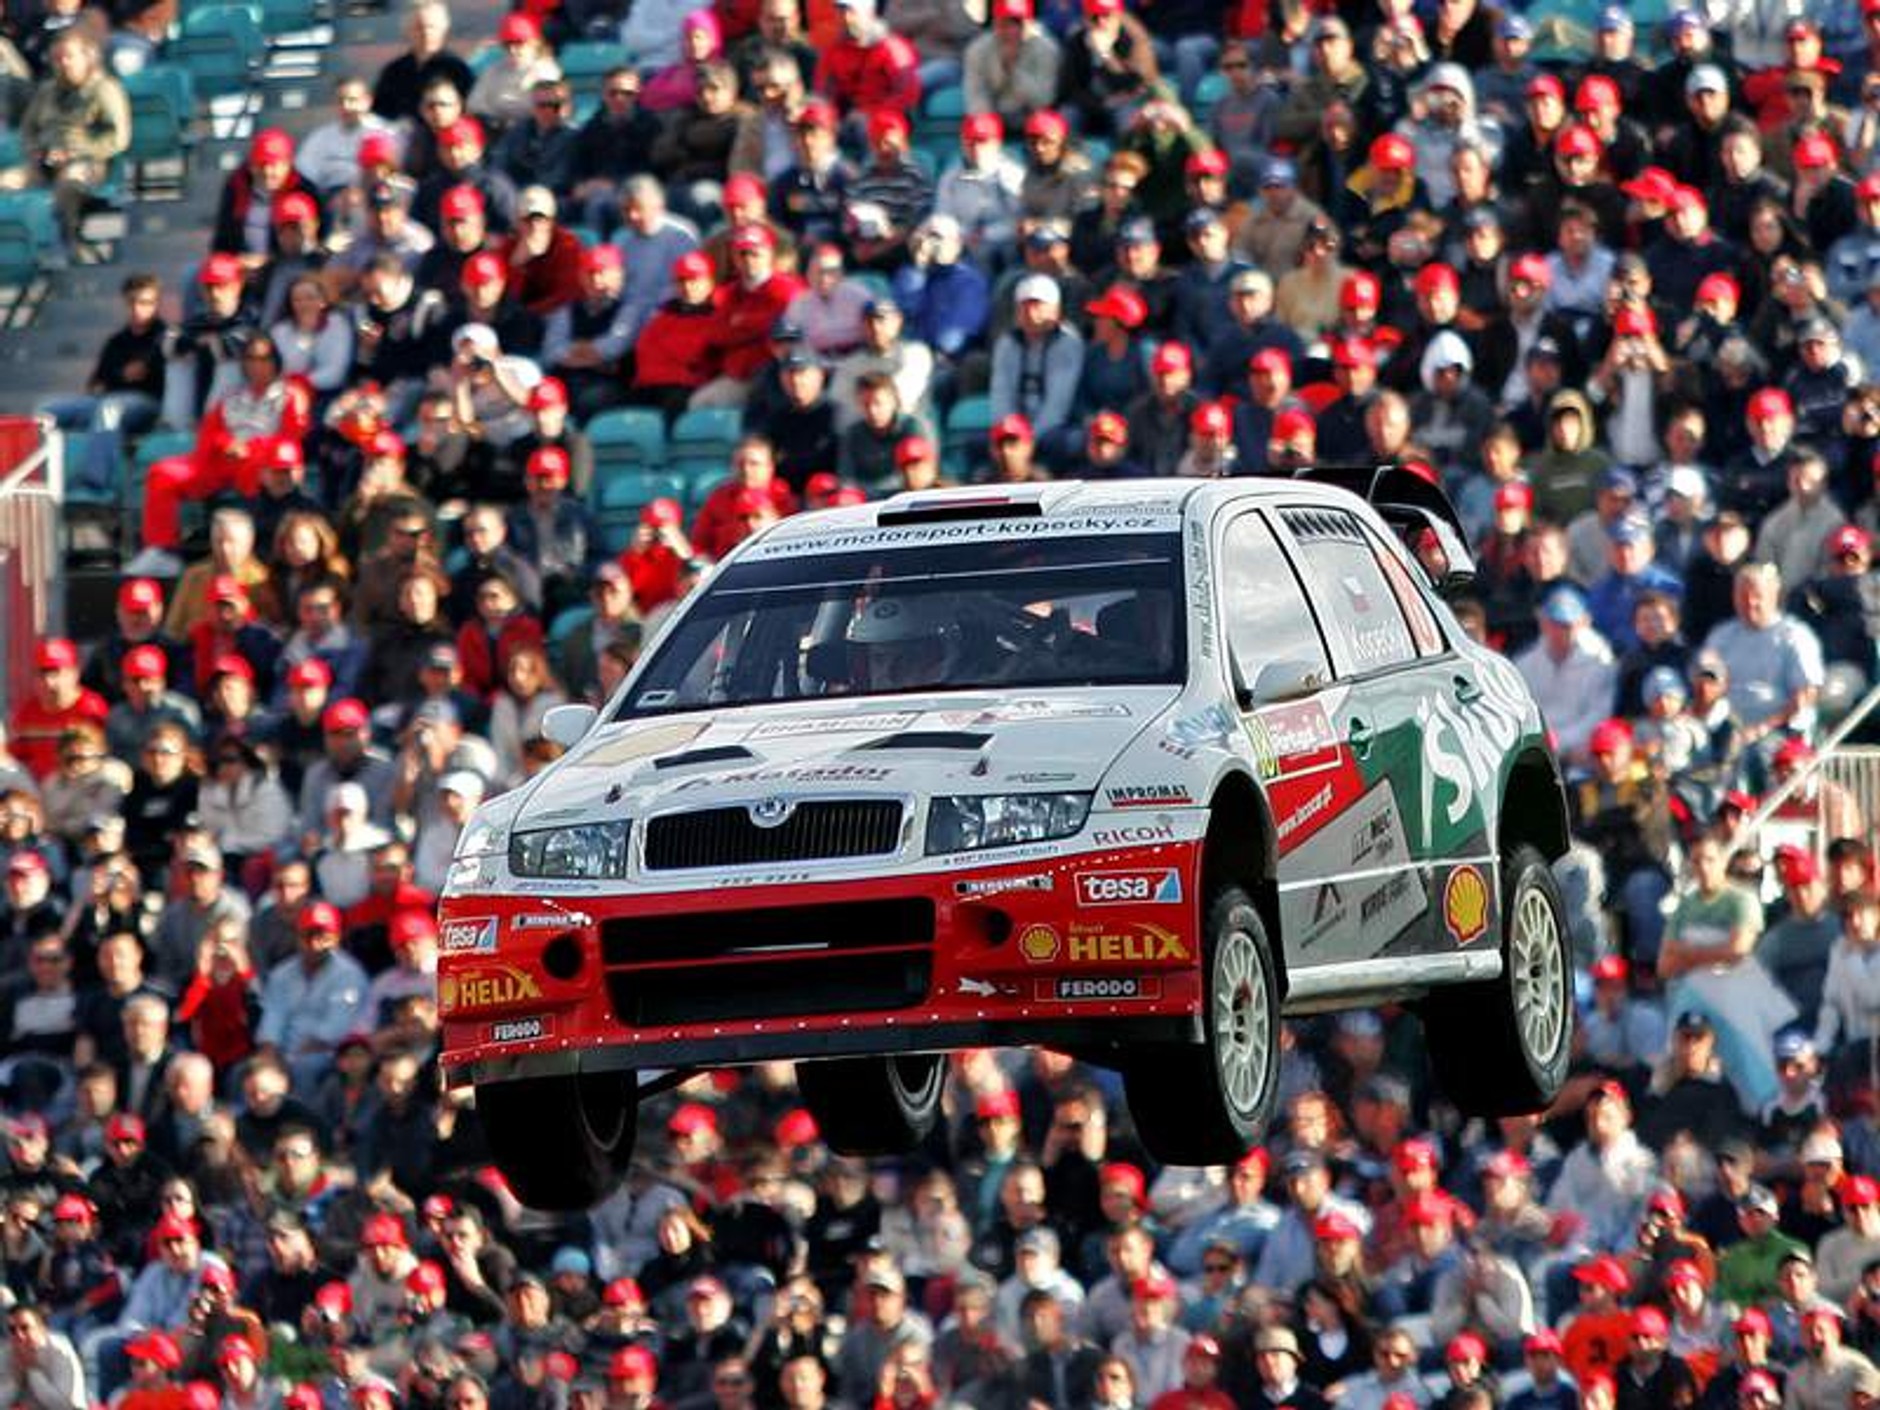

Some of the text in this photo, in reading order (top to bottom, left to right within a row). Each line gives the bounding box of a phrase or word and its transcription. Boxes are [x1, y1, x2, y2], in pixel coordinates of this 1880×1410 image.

[763, 516, 1157, 556] www.motorsport-kopecky.cz
[760, 715, 907, 733] CHAMPION
[723, 765, 894, 783] Matador
[1106, 785, 1188, 801] IMPROMAT
[1093, 826, 1174, 847] RICOH
[1084, 876, 1149, 900] tesa
[446, 926, 477, 949] tesa
[1069, 931, 1190, 961] HELIX
[461, 972, 542, 1008] HELIX
[1060, 980, 1137, 997] FERODO
[494, 1020, 541, 1041] FERODO
